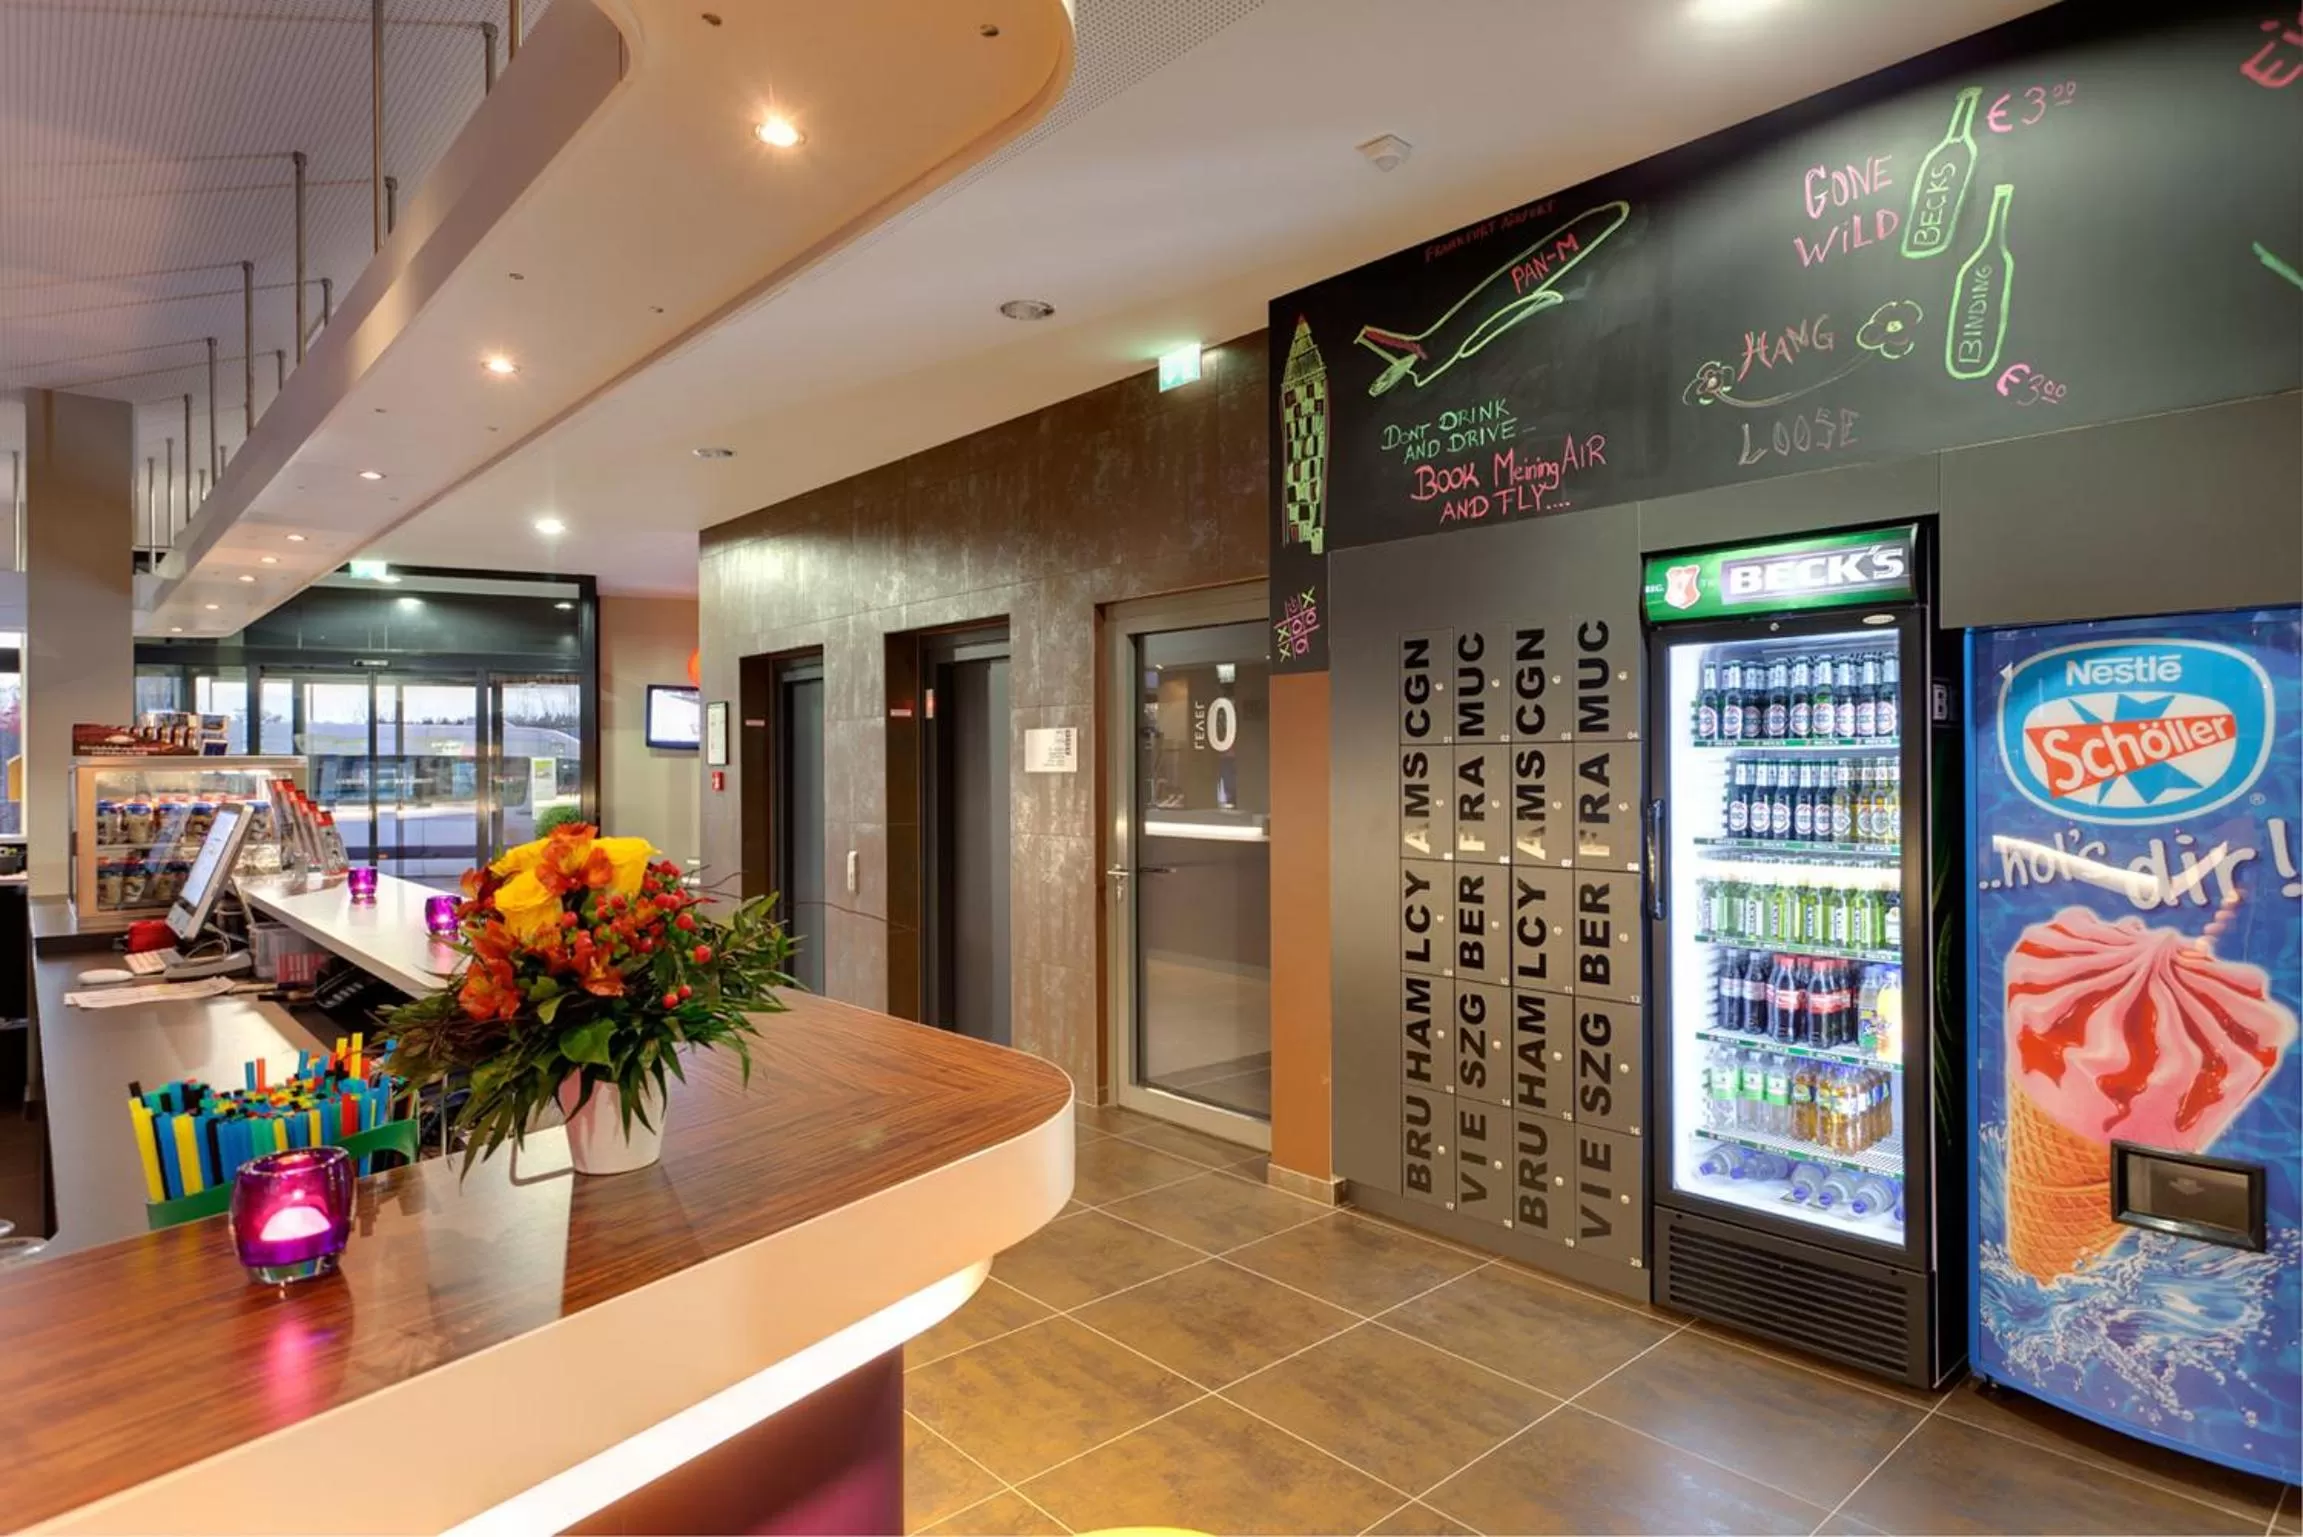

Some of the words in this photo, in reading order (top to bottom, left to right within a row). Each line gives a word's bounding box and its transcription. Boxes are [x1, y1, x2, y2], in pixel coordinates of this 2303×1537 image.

[1804, 155, 1893, 219] GONE
[1914, 162, 1956, 247] BECKS
[1510, 233, 1580, 294] PAN-M
[1738, 314, 1834, 383] HANG
[1958, 263, 1993, 364] BINDING
[1404, 439, 1441, 464] AND
[1438, 398, 1511, 430] DRINK
[1738, 407, 1860, 465] LOOSE
[1410, 461, 1480, 501] BOOK
[1561, 432, 1607, 475] AIR
[1440, 495, 1490, 526] AND
[1730, 545, 1904, 595] BECK'S
[1404, 638, 1430, 737] CGN
[1458, 631, 1485, 736] MUC
[1516, 628, 1545, 735] CGN
[1578, 620, 1610, 733] MUC
[2066, 654, 2182, 686] Nestlé
[1207, 697, 1236, 752] 0
[2042, 715, 2229, 791] Schöller
[1403, 751, 1430, 854] AMS
[1458, 756, 1485, 851] FRA
[1516, 750, 1546, 860] AMS
[1579, 753, 1610, 857] FRA
[1405, 870, 1430, 962] LCY
[1459, 875, 1484, 970] BER
[1517, 878, 1547, 979] LCY
[1580, 883, 1610, 984] BER
[1406, 977, 1431, 1083] HAM
[1460, 993, 1486, 1089] SZG
[1517, 994, 1546, 1109] HAM
[1580, 1012, 1612, 1116] SZG
[1406, 1094, 1432, 1194] BRU
[1460, 1111, 1487, 1203] VIE
[1518, 1121, 1548, 1230] BRU
[1580, 1138, 1611, 1239] VIE
